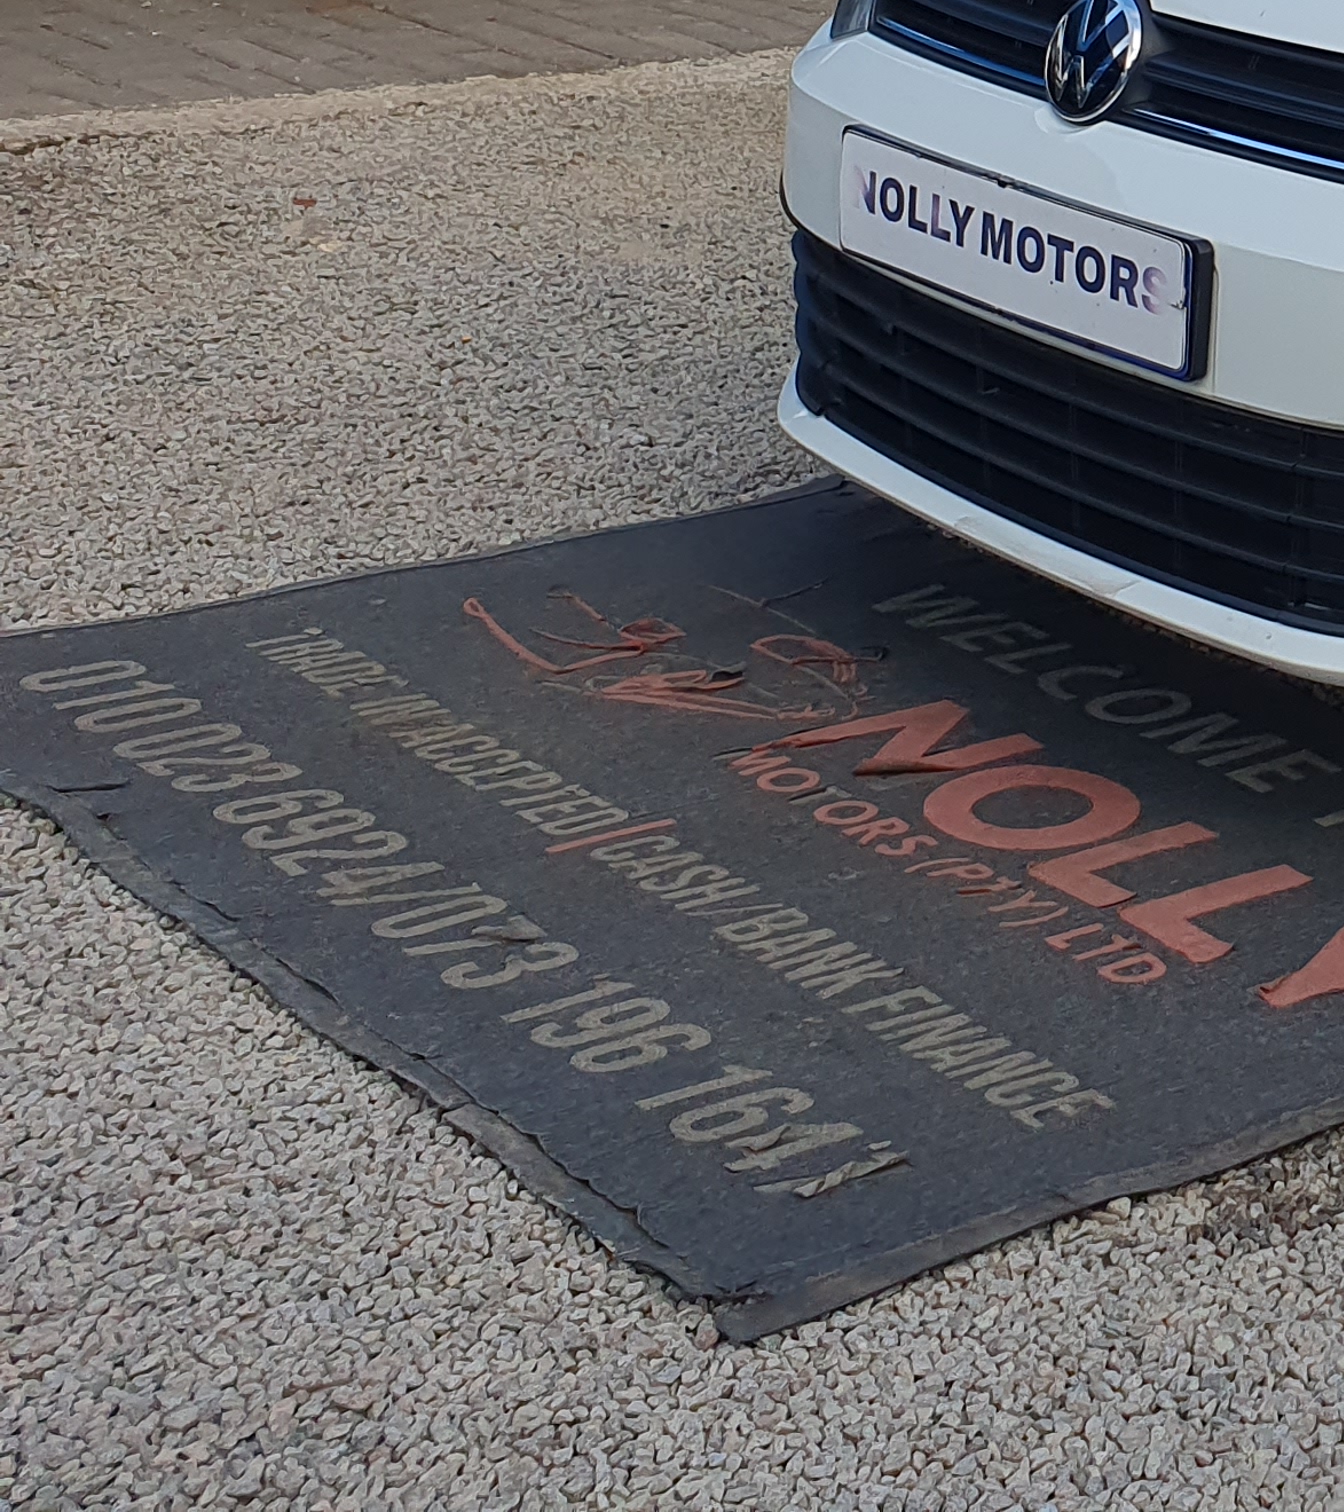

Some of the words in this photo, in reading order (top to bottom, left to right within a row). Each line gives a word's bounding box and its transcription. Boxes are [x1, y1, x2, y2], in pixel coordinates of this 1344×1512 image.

[853, 164, 975, 248] NOLLY
[980, 211, 1167, 316] MOTORS
[871, 584, 1342, 793] WELCOME
[19, 660, 202, 734] 010
[112, 723, 304, 793] 023
[502, 974, 712, 1073] 196
[388, 722, 630, 836] ACCEPTED
[840, 985, 1116, 1130] FINANCE
[729, 748, 939, 857] MOTORS
[904, 857, 1069, 929] (PTY)
[1046, 922, 1168, 985] LTD
